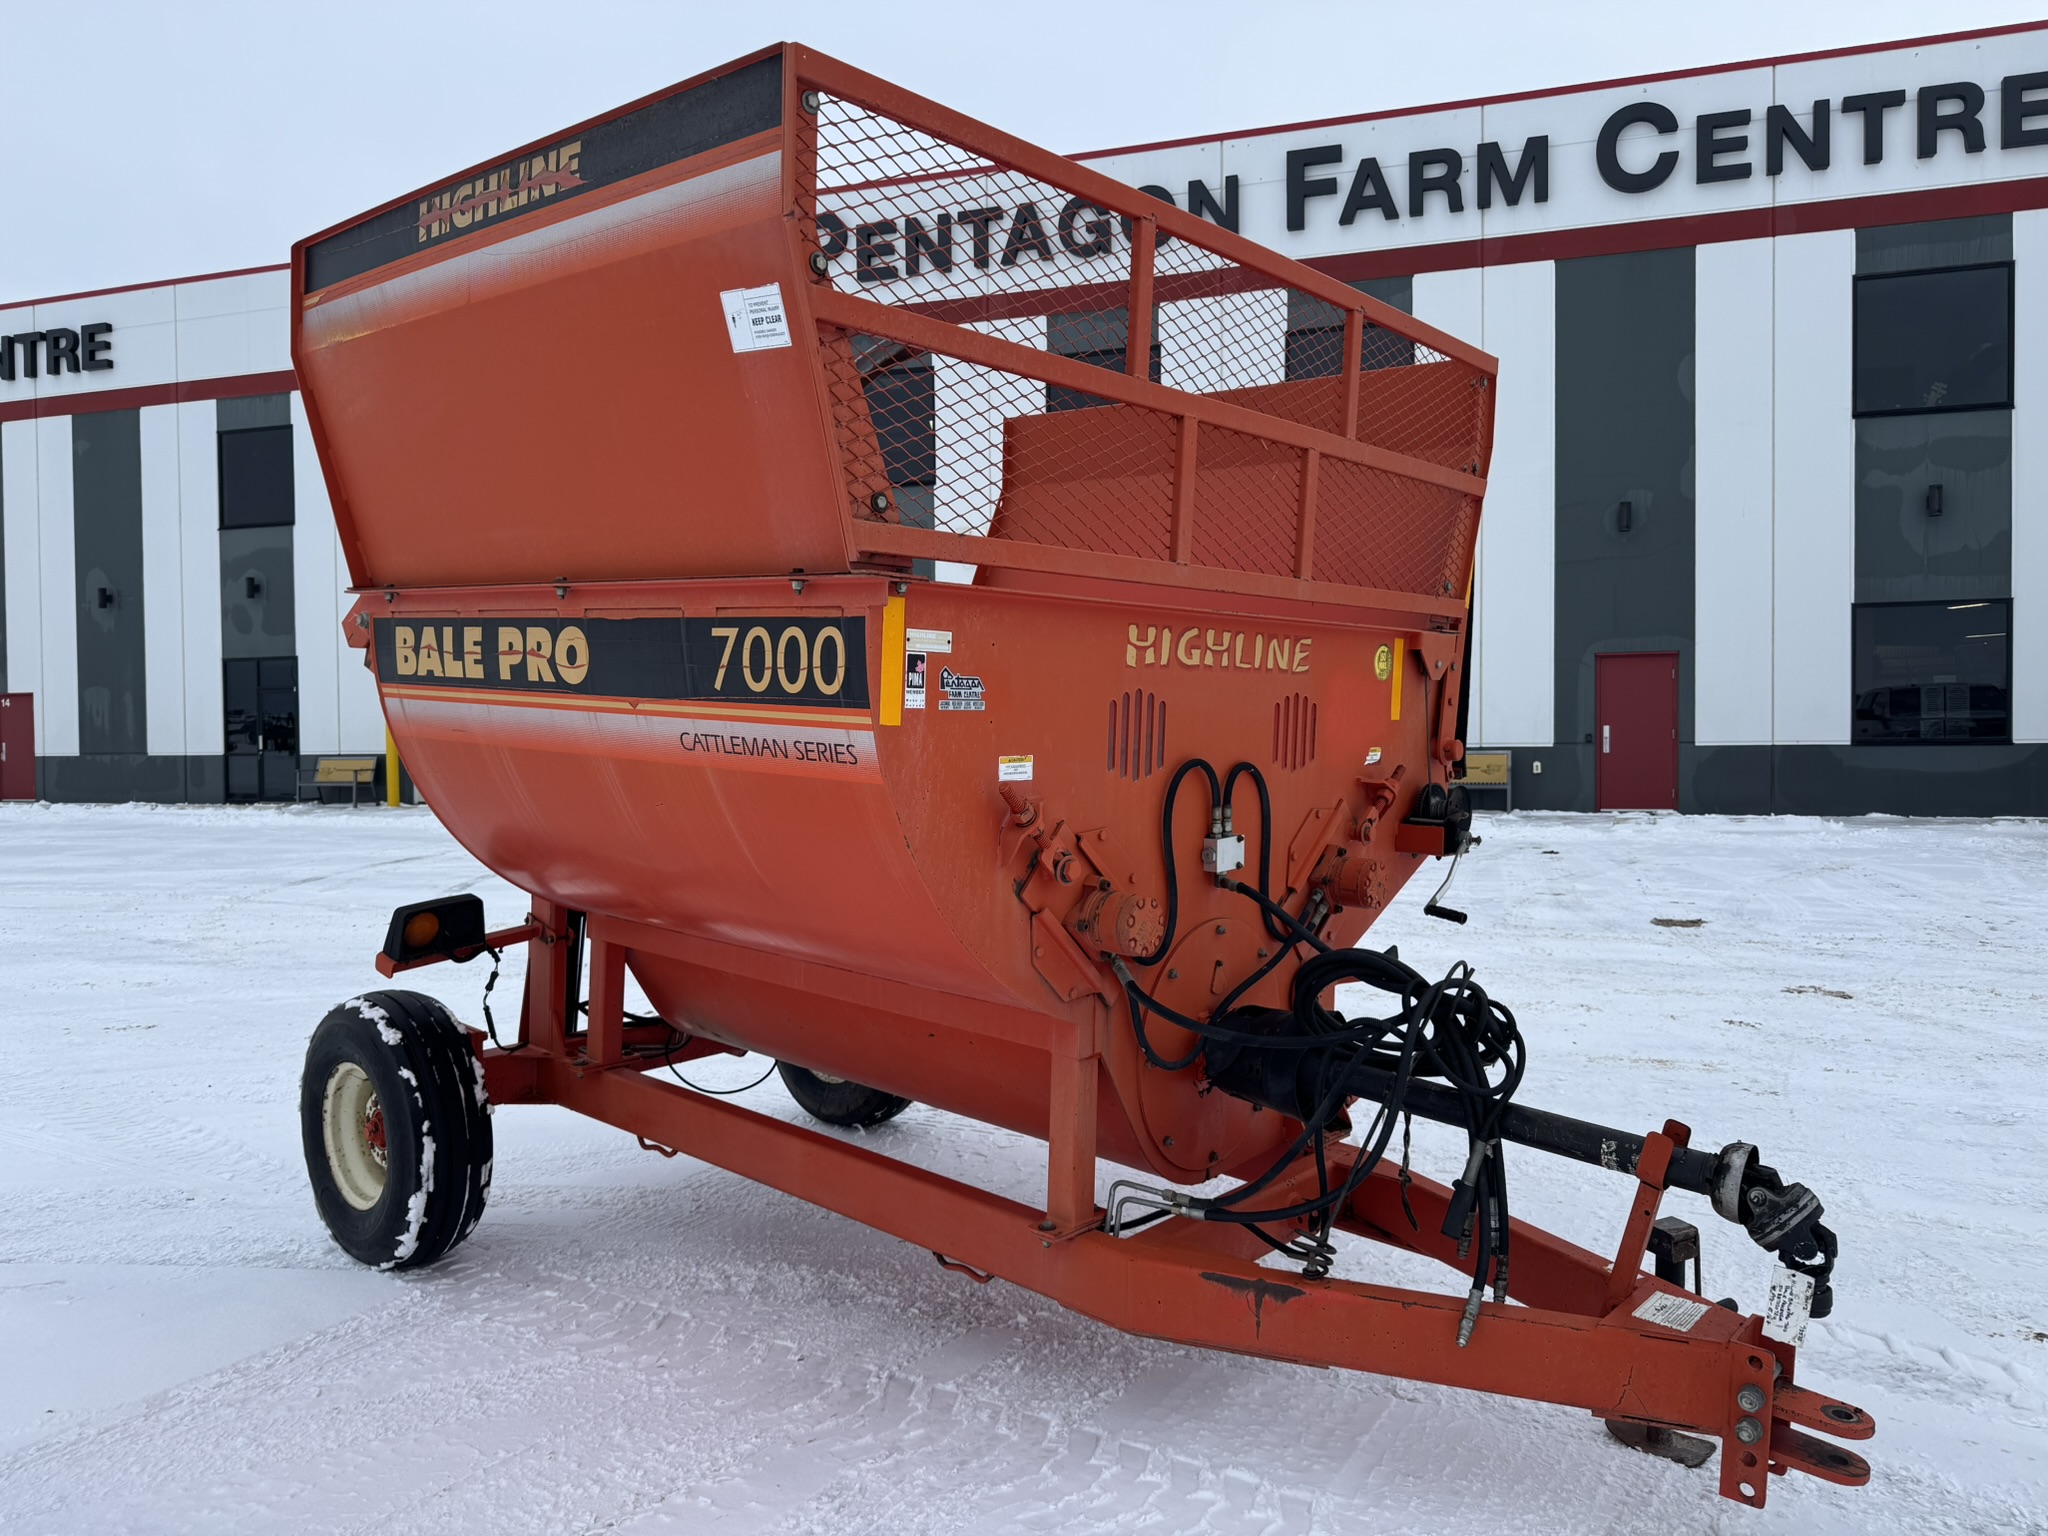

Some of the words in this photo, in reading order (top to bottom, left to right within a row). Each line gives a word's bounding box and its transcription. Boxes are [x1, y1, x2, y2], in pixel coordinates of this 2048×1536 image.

[1286, 134, 1549, 231] FARM
[1596, 71, 2048, 193] CENTRE
[418, 140, 582, 243] HIGHLINE
[752, 317, 764, 326] KEEP
[765, 315, 782, 324] CLEAR
[395, 626, 485, 679] BALE
[498, 626, 589, 685] PRO
[711, 626, 846, 695] 7000
[1126, 624, 1312, 672] HIGHLINE
[679, 731, 788, 759] CATTLEMAN
[792, 740, 858, 765] SERIES
